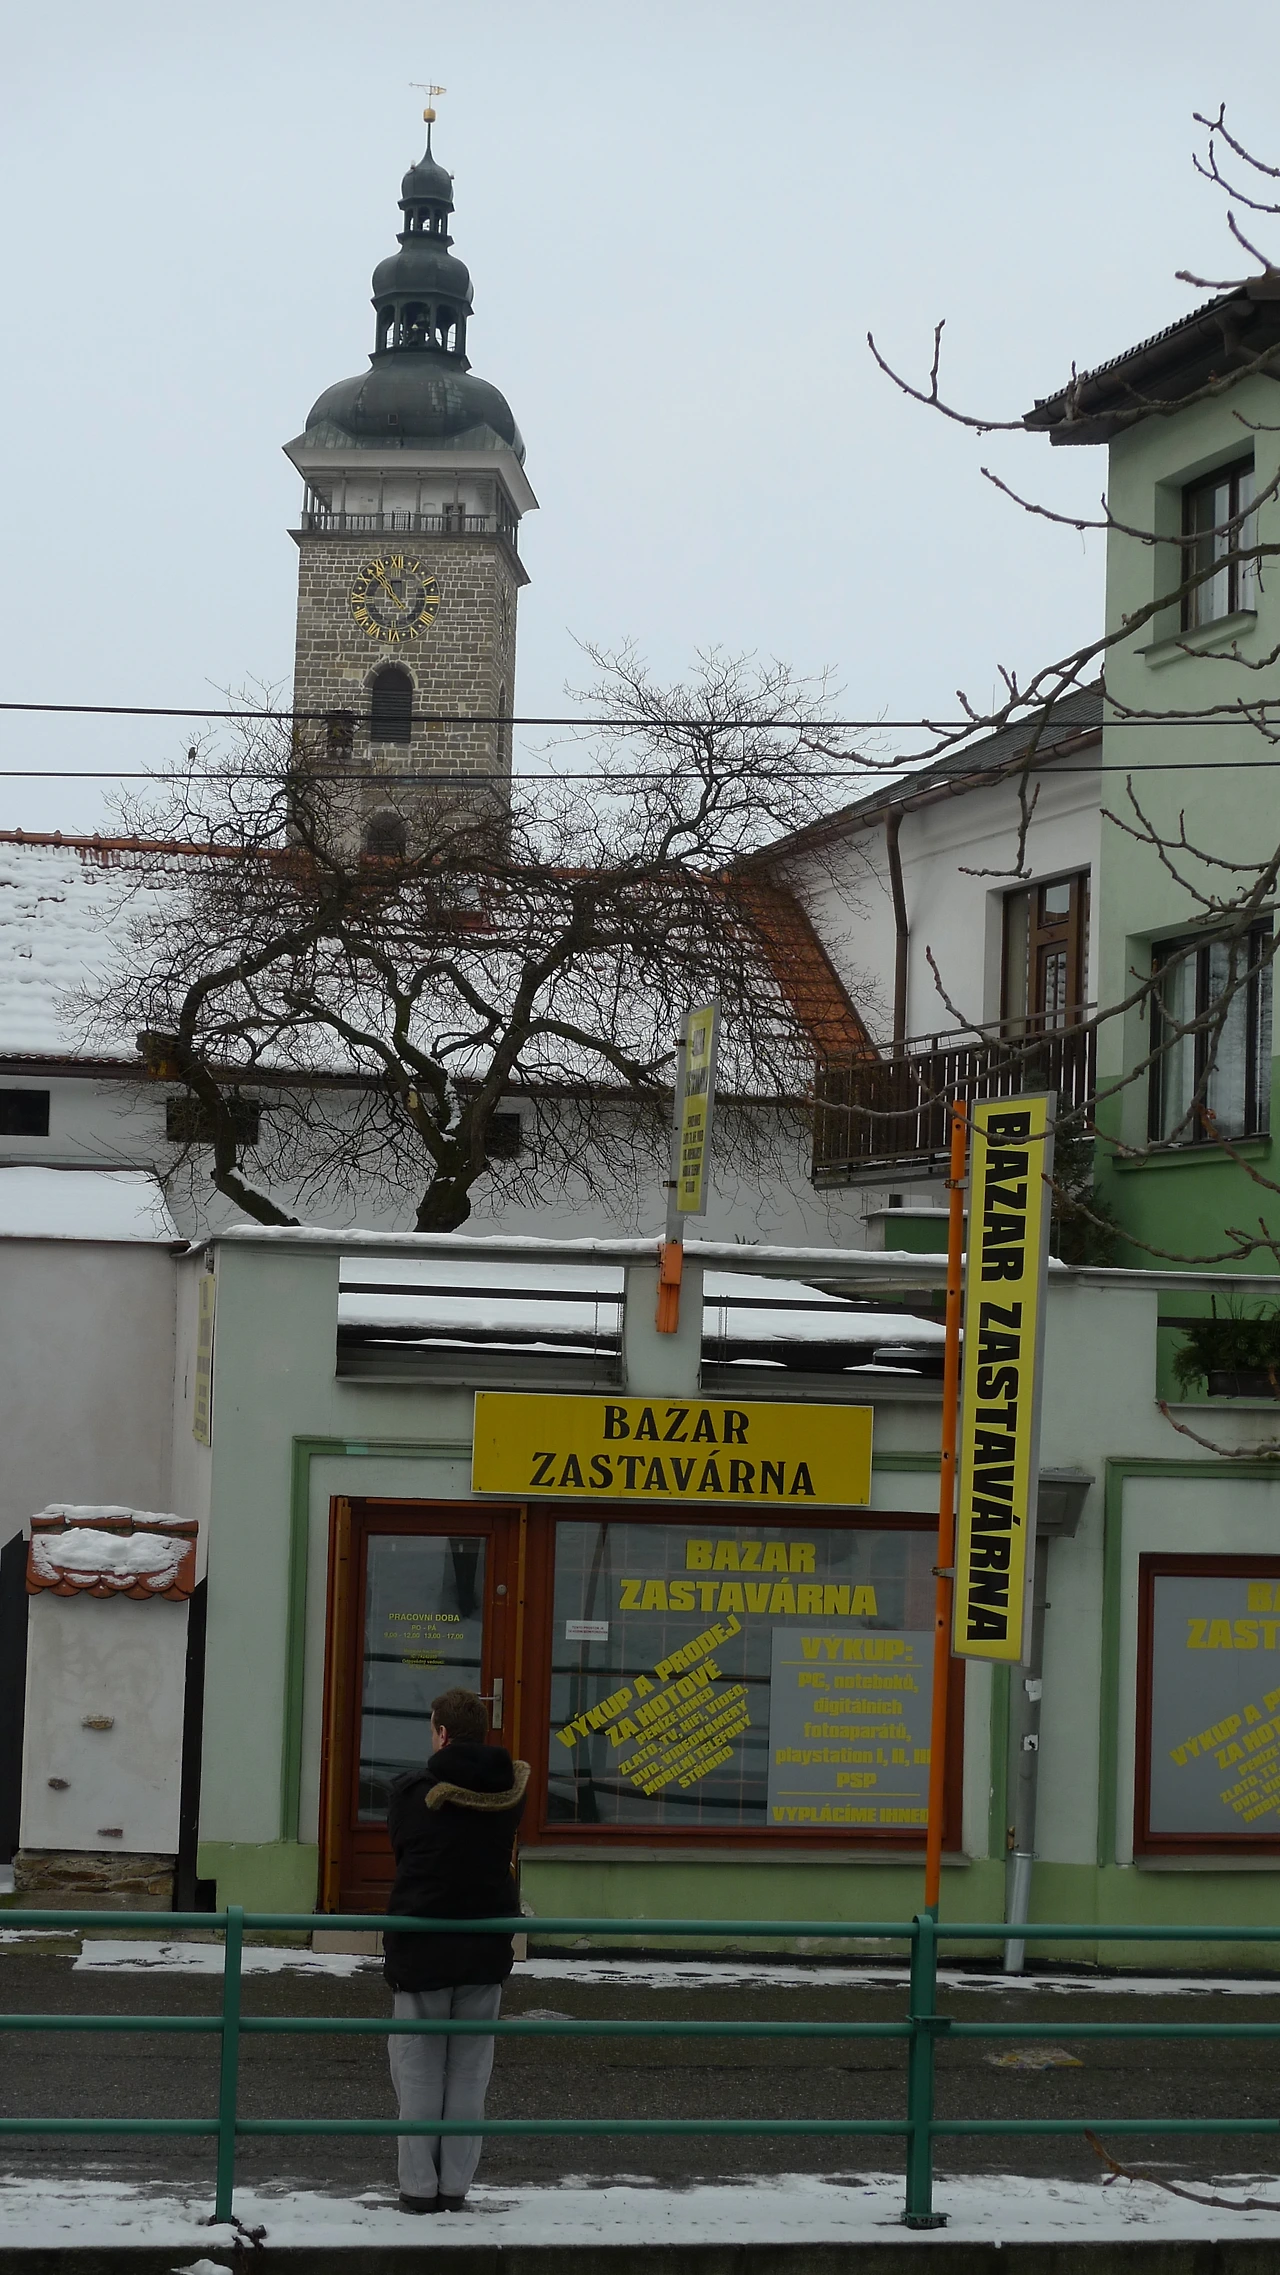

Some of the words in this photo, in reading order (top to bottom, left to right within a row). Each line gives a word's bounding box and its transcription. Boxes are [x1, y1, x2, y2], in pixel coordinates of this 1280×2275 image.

[391, 555, 403, 568] XII
[357, 573, 371, 585] X
[422, 576, 435, 586] II
[351, 592, 365, 603] IX
[426, 595, 440, 604] III
[388, 630, 400, 642] VI
[981, 1111, 1032, 1283] BAZAR
[602, 1405, 750, 1445] BAZAR
[529, 1450, 816, 1496] ZASTAVÁRNA
[966, 1301, 1023, 1643] ZASTAVÁRNA
[685, 1539, 816, 1573] BAZAR
[619, 1577, 878, 1616] ZASTAVÁRNA
[1247, 1581, 1280, 1612] B
[435, 1614, 460, 1622] DOBA
[801, 1634, 913, 1662] VÝKUP:
[555, 1687, 633, 1748] VÝKUP
[633, 1675, 655, 1698] A
[653, 1613, 742, 1683] PRODEJ
[798, 1672, 830, 1691] PC,
[604, 1717, 640, 1748] ZA
[634, 1657, 722, 1727] HOTOVÉ
[635, 1713, 678, 1746] PENÍZE
[675, 1686, 715, 1718] IHNED
[813, 1697, 903, 1716] digitálních
[618, 1743, 663, 1775] ZLATO,
[658, 1728, 683, 1746] TV,
[704, 1684, 749, 1715] VIDEO,
[630, 1760, 665, 1787] DVD,
[660, 1699, 748, 1764] VIDEOKAMERY
[804, 1722, 912, 1742] fotoaparátů,
[1169, 1713, 1241, 1767] VÝKUP
[1243, 1703, 1262, 1725] A
[642, 1752, 695, 1796] MOBILNÍ
[693, 1714, 752, 1759] TELEFONY
[678, 1745, 734, 1789] STŘÍBRO
[775, 1746, 873, 1766] playstation
[1214, 1742, 1245, 1770] ZA
[1238, 1744, 1279, 1776] PENÍZE
[836, 1772, 877, 1788] PSP
[1220, 1774, 1263, 1804] ZLATO,
[772, 1803, 876, 1822] VYPLÁCÍME
